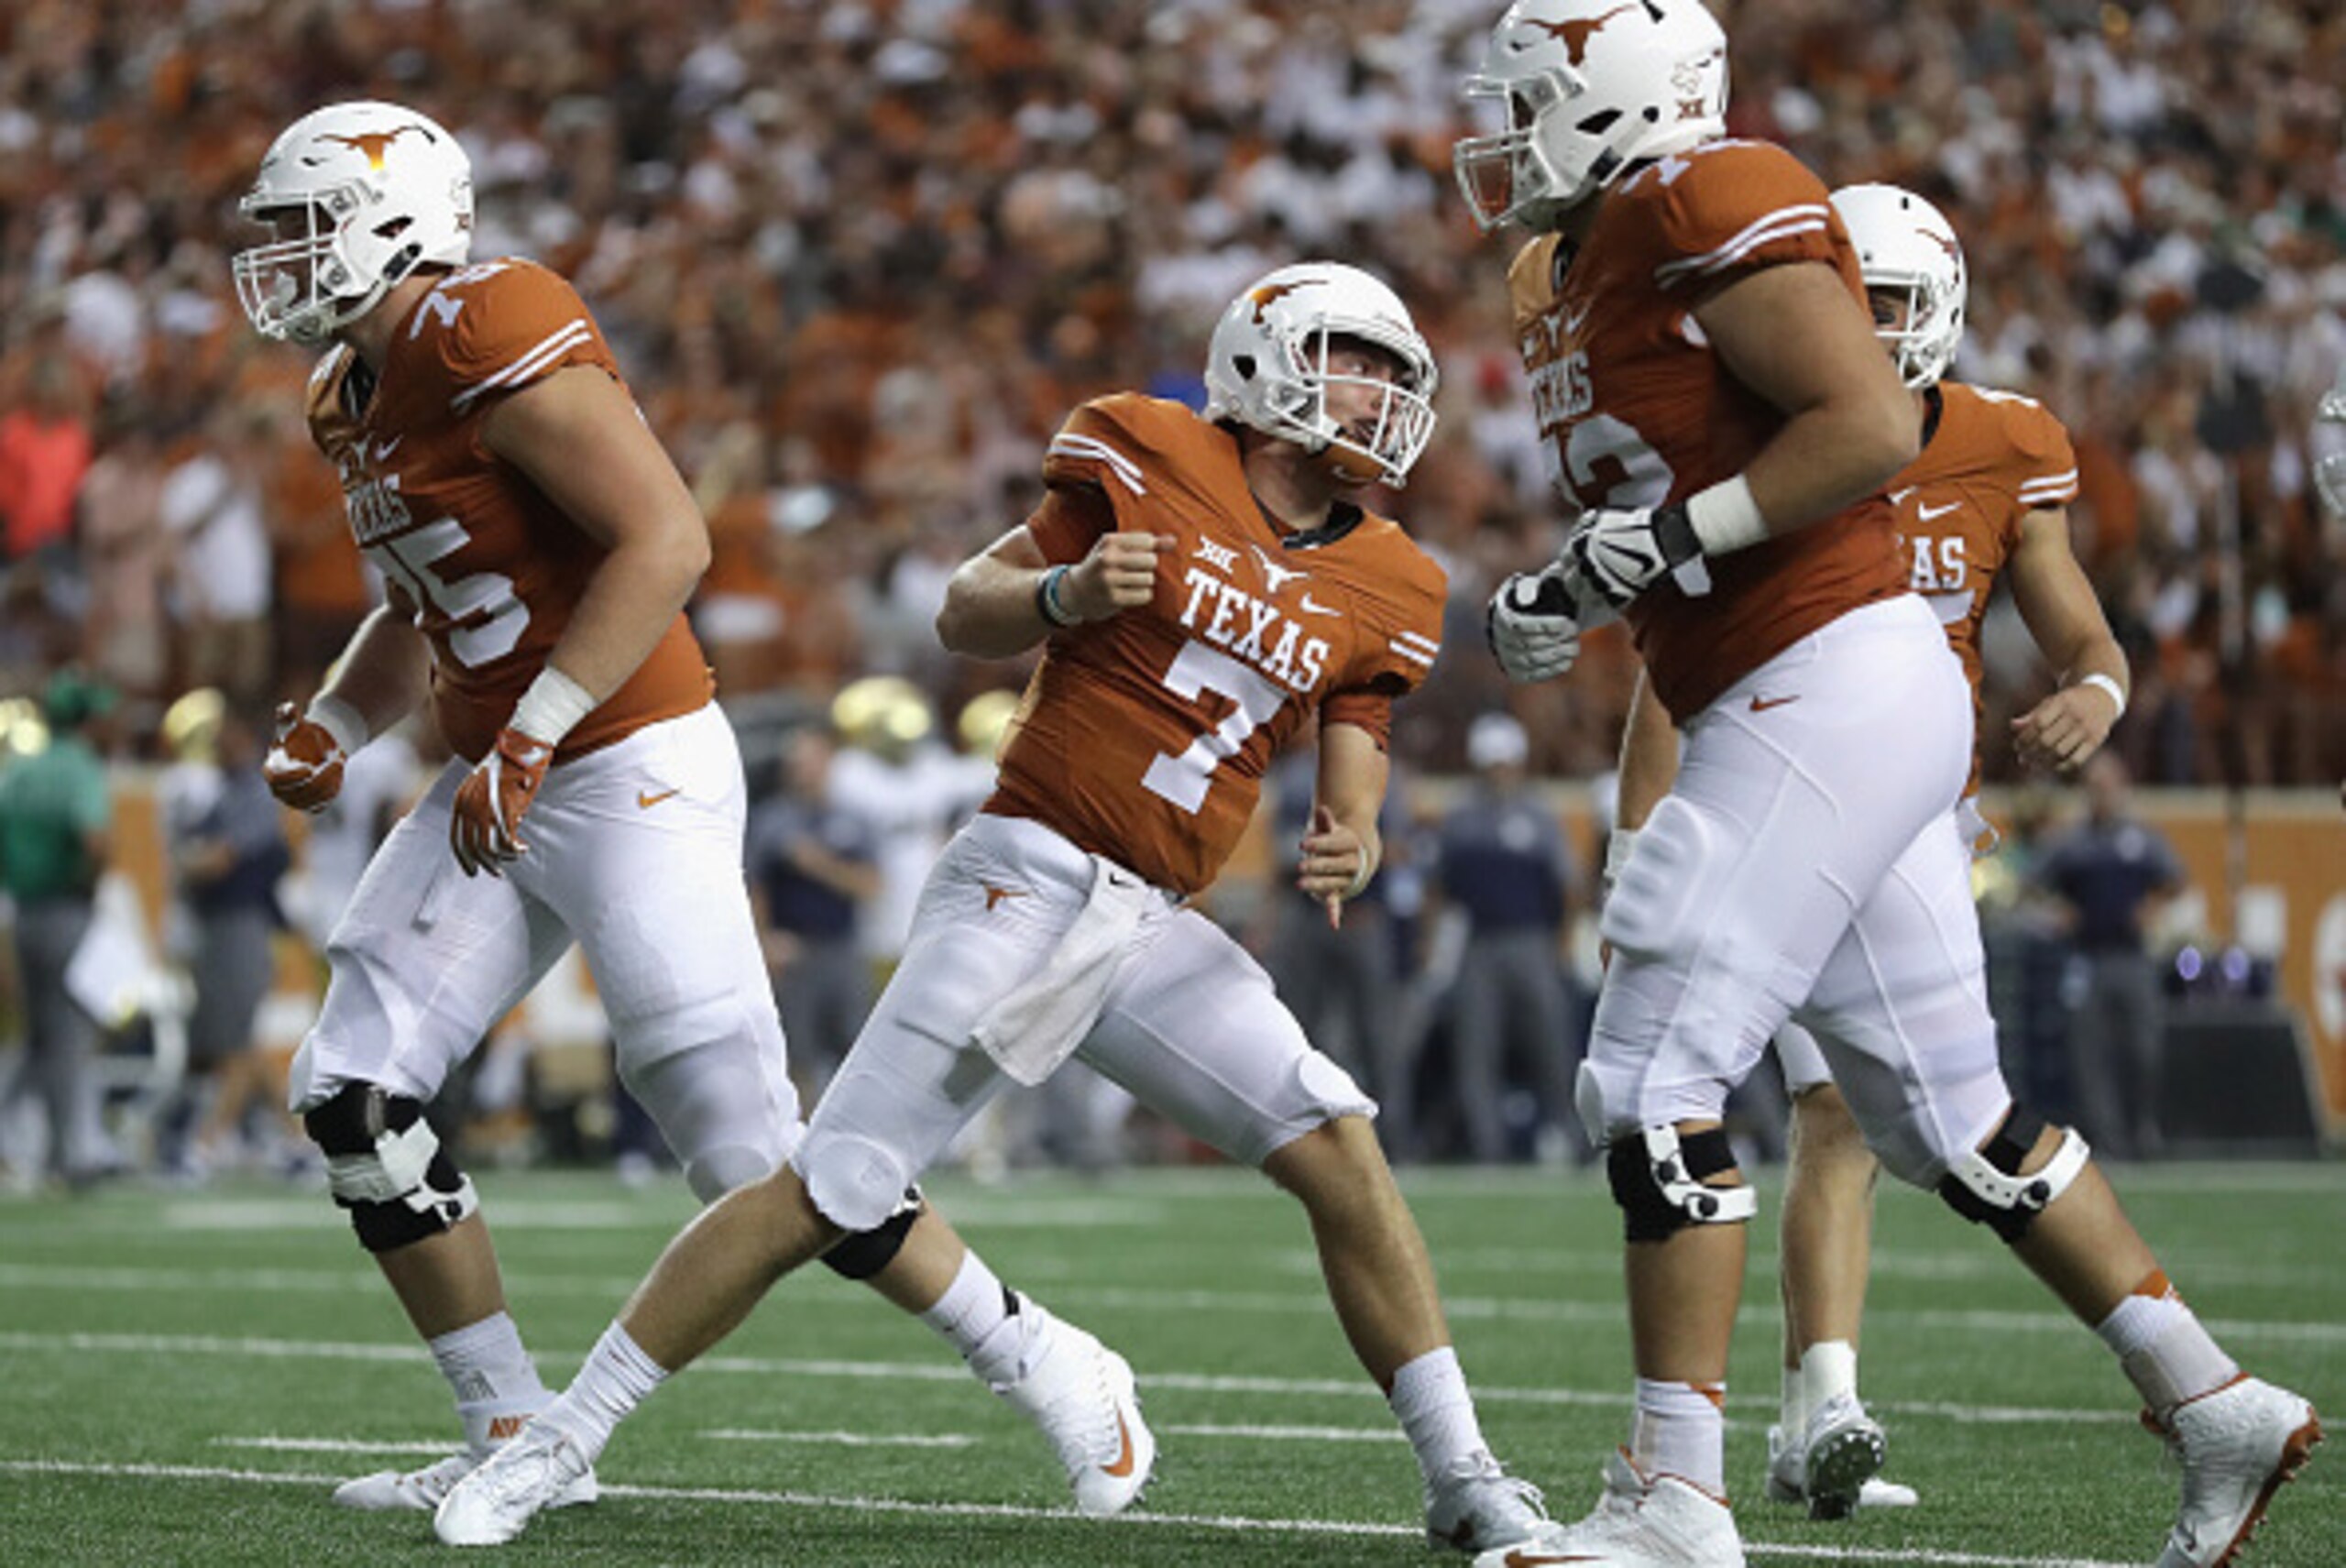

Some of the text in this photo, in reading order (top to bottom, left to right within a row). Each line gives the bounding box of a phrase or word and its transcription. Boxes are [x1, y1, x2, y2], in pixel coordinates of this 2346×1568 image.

[1896, 533, 1967, 589] AS
[1179, 567, 1331, 693] TEXAS
[1140, 638, 1289, 816] 7
